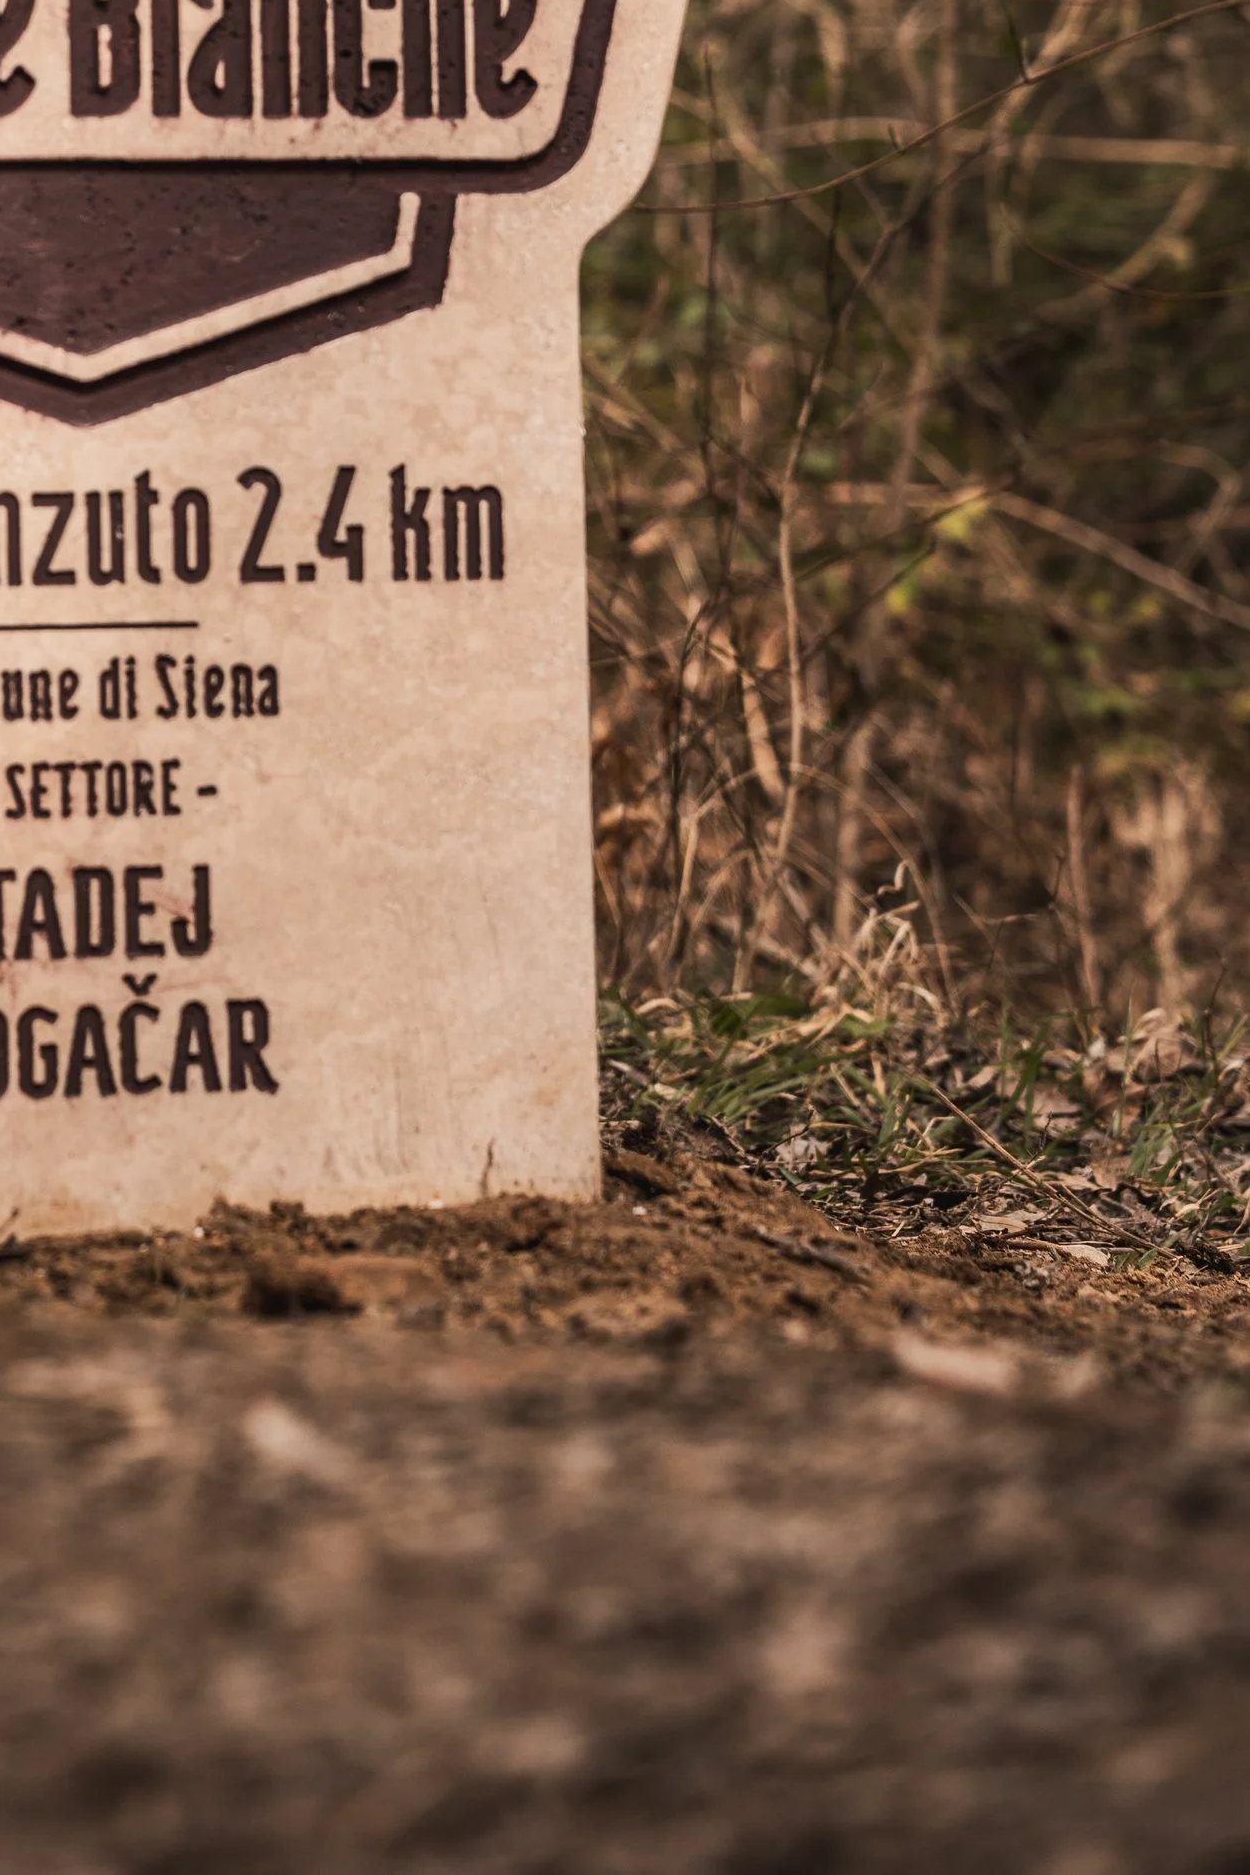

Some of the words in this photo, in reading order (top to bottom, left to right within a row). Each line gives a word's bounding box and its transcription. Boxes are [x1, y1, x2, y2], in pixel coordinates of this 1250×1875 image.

[236, 465, 366, 586] 2.4
[388, 463, 506, 583] km
[99, 655, 139, 721] di
[154, 653, 281, 720] Siena
